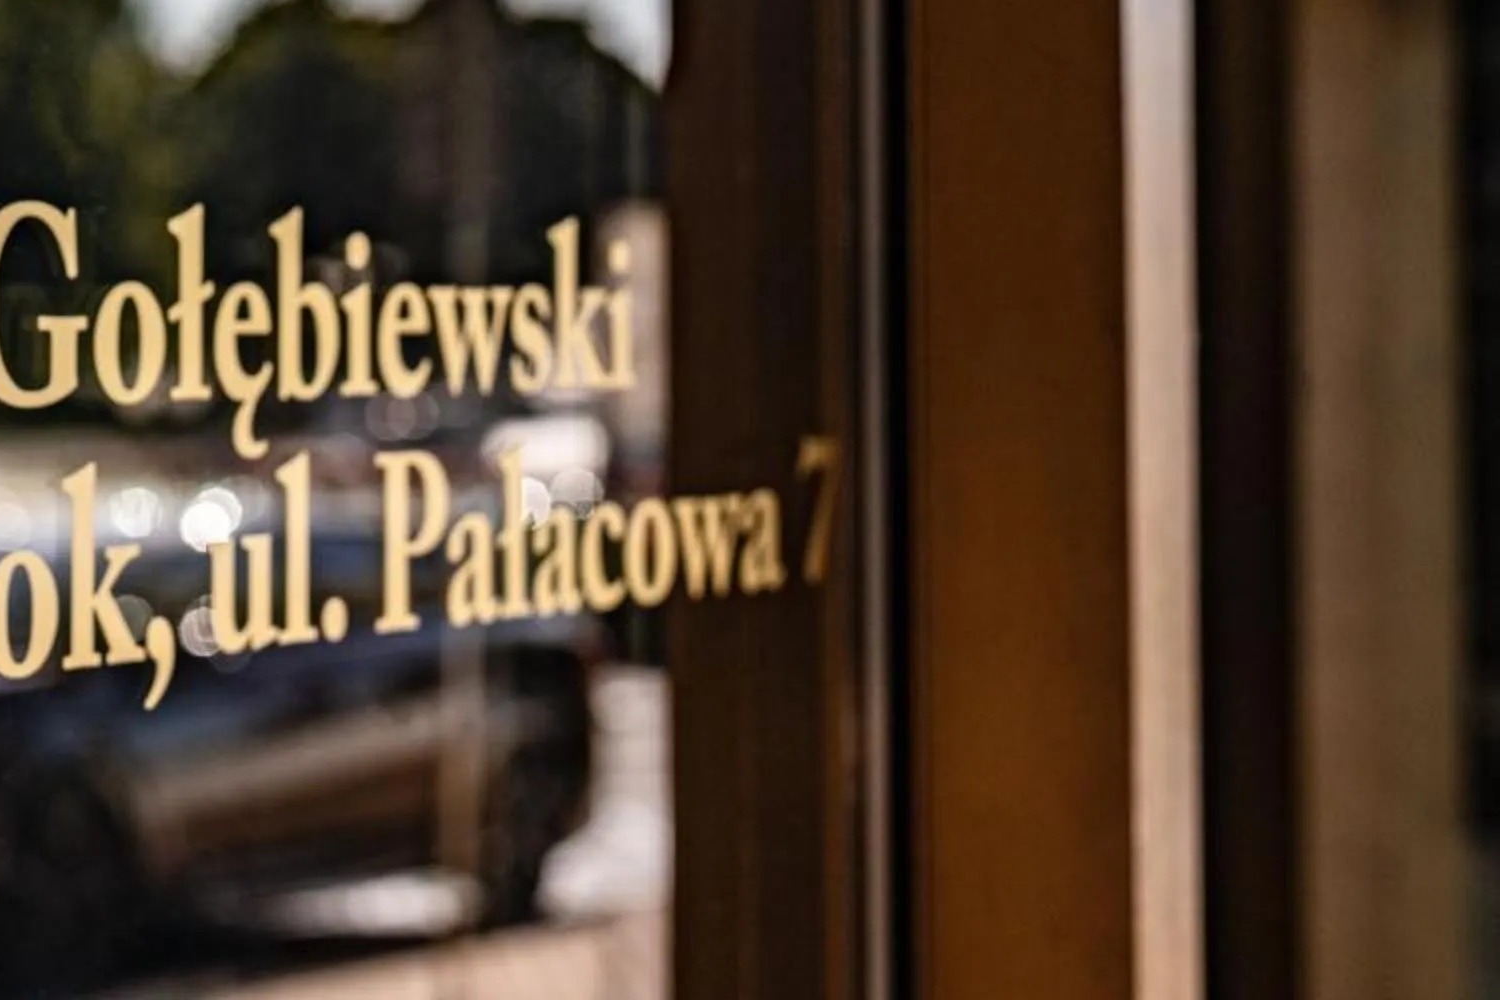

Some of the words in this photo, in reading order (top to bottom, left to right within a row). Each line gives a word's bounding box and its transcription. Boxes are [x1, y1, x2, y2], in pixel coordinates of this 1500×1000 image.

[206, 452, 349, 655] ul.
[374, 450, 786, 636] Pałacowa
[795, 434, 841, 583] 7
